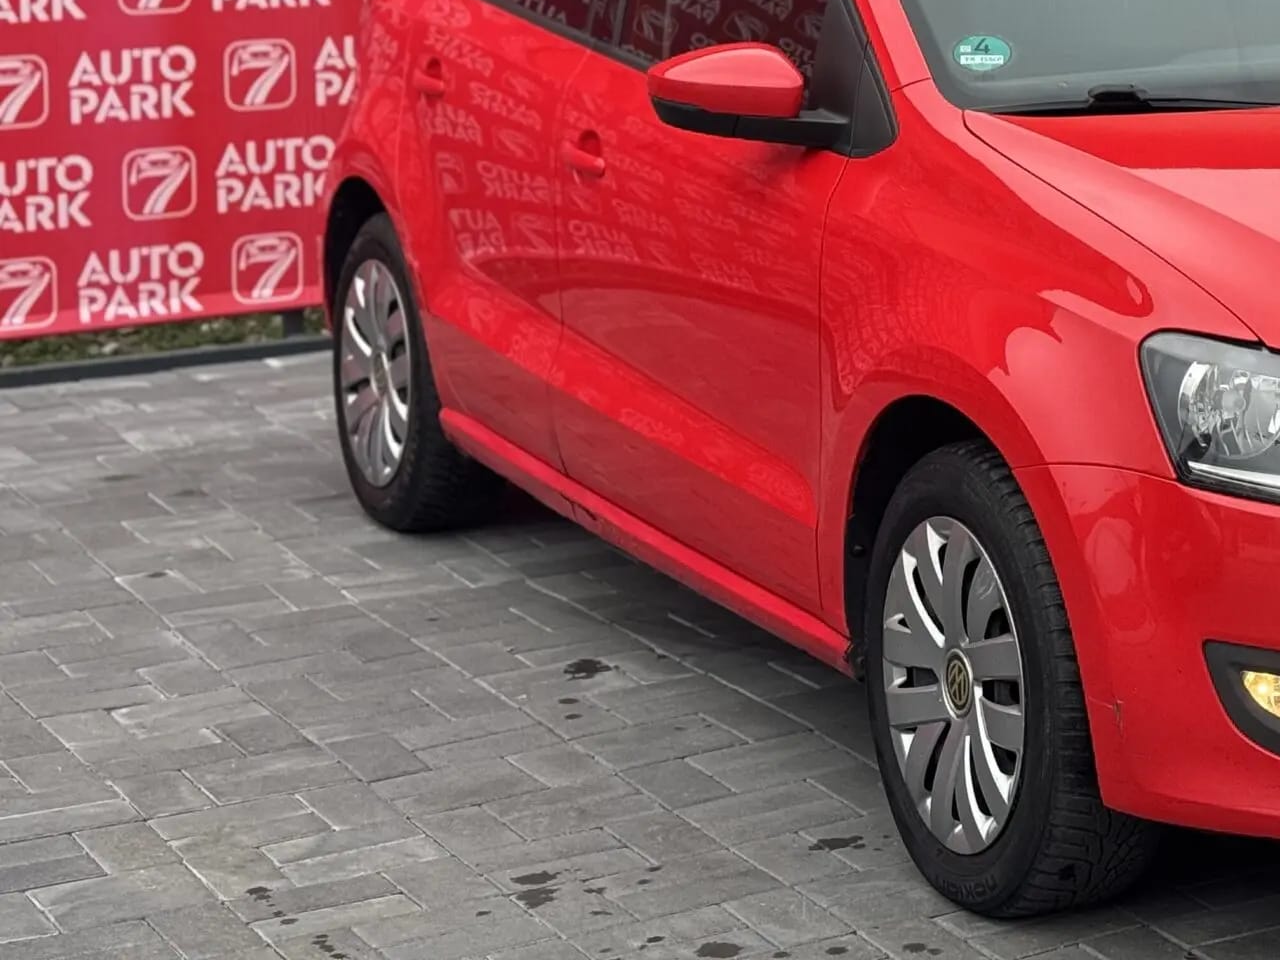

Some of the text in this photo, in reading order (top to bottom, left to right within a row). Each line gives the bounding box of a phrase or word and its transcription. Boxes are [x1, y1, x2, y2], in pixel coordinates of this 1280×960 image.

[69, 46, 196, 88] AUTO
[70, 81, 193, 124] PARK
[216, 135, 335, 178] AUTO
[217, 172, 326, 213] PARK
[78, 242, 203, 288] AUTO
[79, 278, 204, 324] PARK
